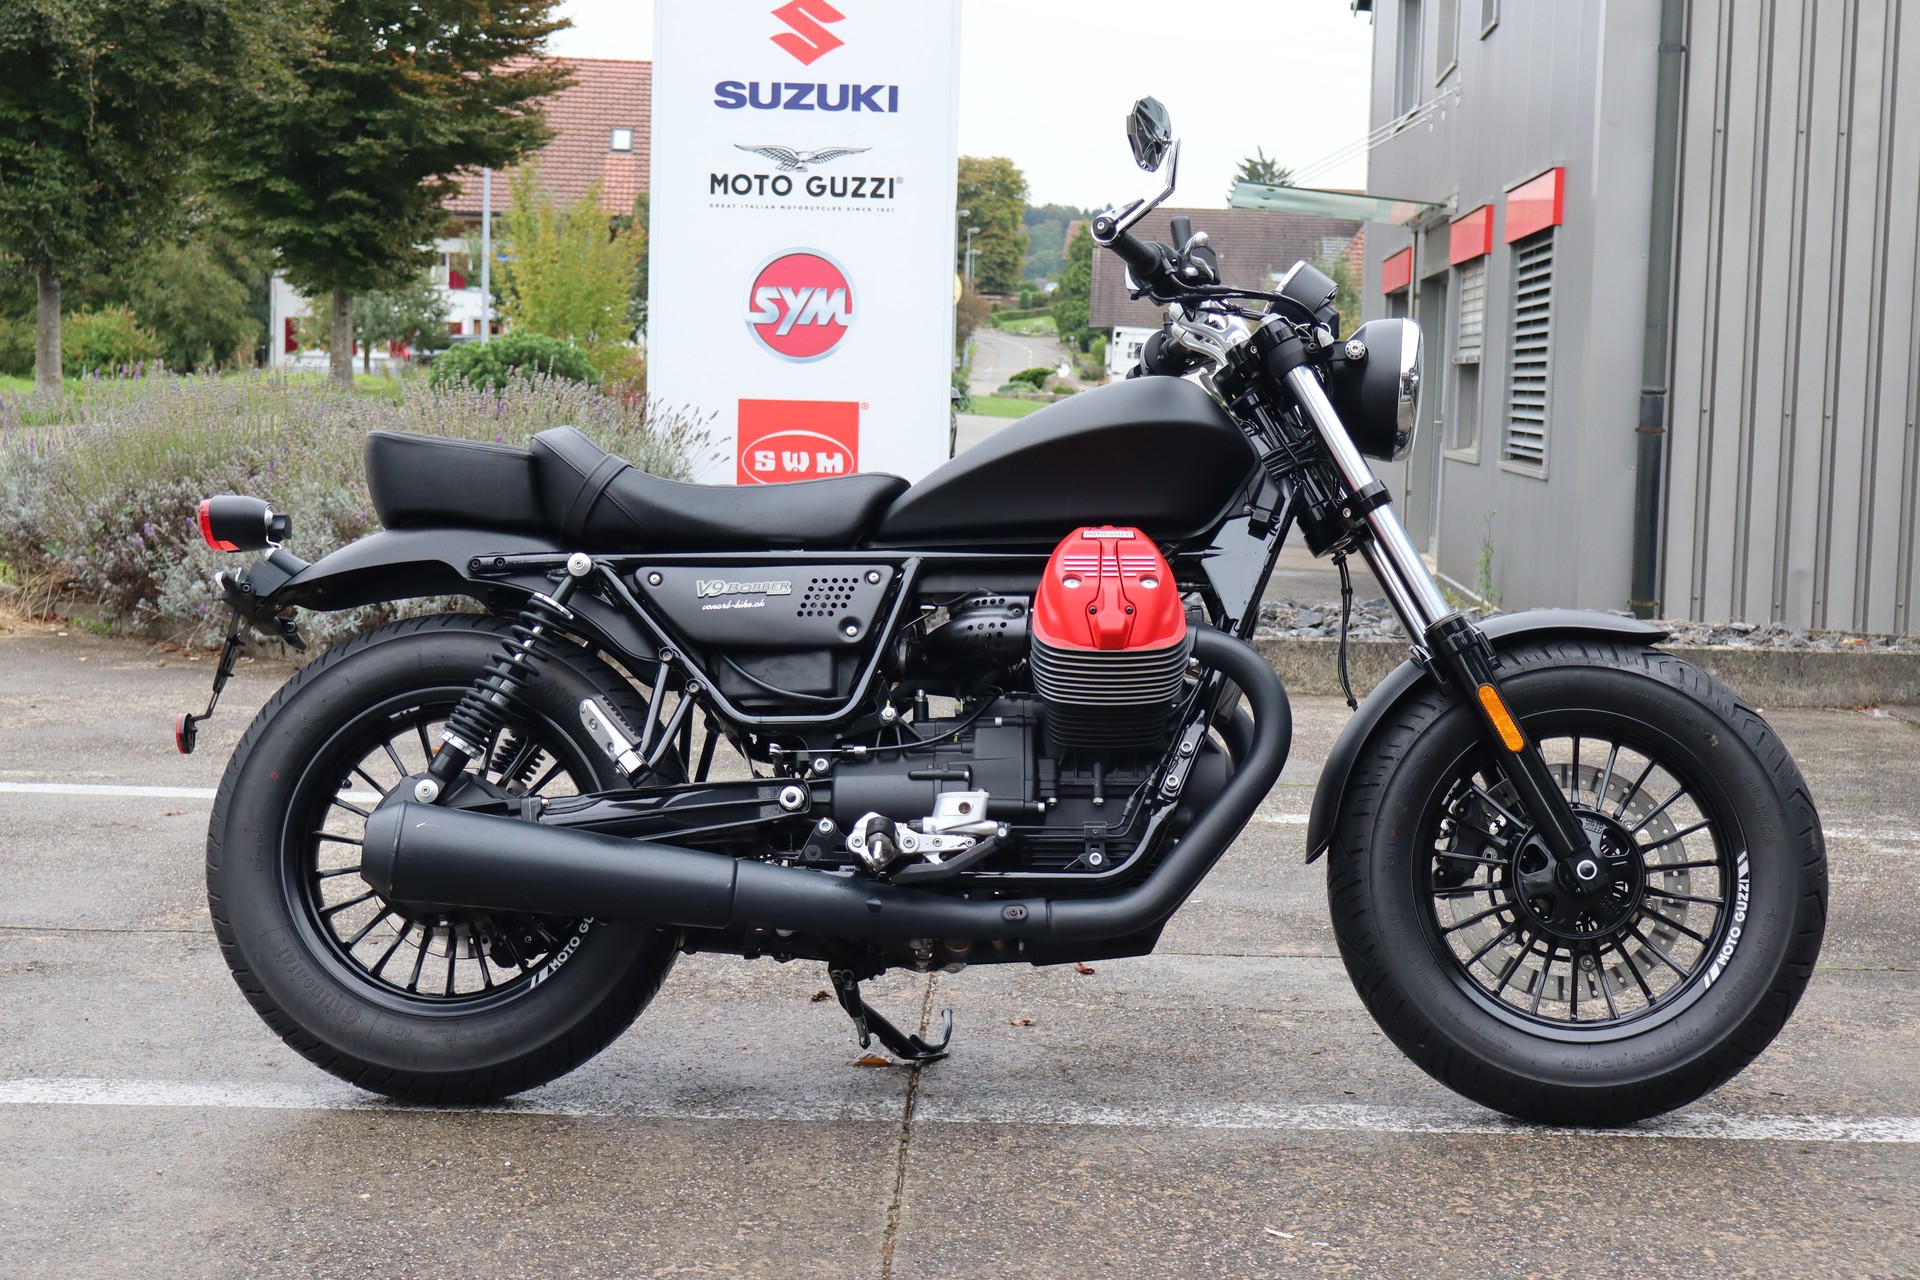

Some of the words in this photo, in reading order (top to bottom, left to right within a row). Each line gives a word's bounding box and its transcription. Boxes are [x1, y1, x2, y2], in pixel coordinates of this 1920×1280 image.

[714, 80, 899, 113] SUZUKI
[710, 173, 793, 196] MOTO
[806, 176, 894, 199] GUZZI
[747, 286, 853, 336] SYM
[754, 451, 844, 474] SWM
[696, 580, 725, 598] V9
[726, 581, 791, 595] BOBBER
[1716, 927, 1742, 966] MOTO
[1734, 878, 1750, 923] GUZZI
[549, 936, 580, 971] MOTO
